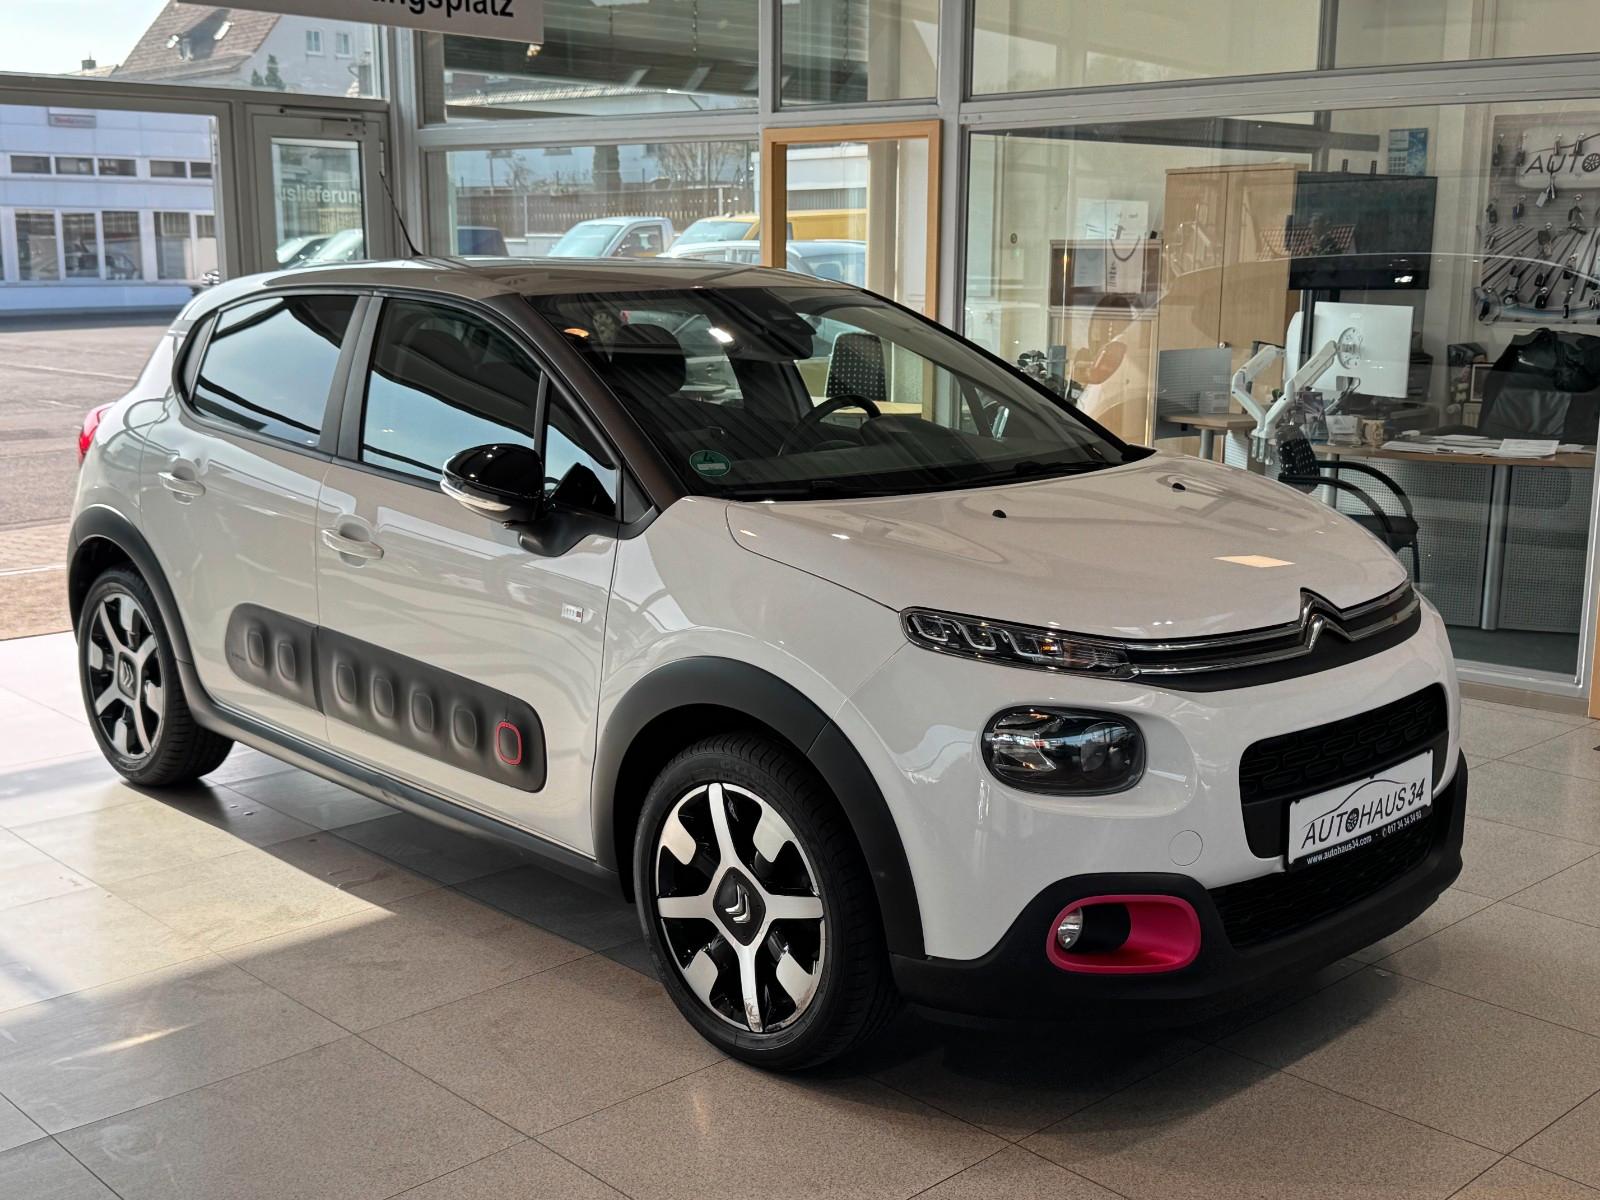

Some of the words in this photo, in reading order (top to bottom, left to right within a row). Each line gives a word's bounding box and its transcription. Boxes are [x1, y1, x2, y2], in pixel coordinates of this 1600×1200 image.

[371, 0, 514, 17] gsplatz
[277, 184, 361, 206] uslieferun
[1407, 777, 1426, 806] 34
[1306, 834, 1373, 865] www.autohaus34.com
